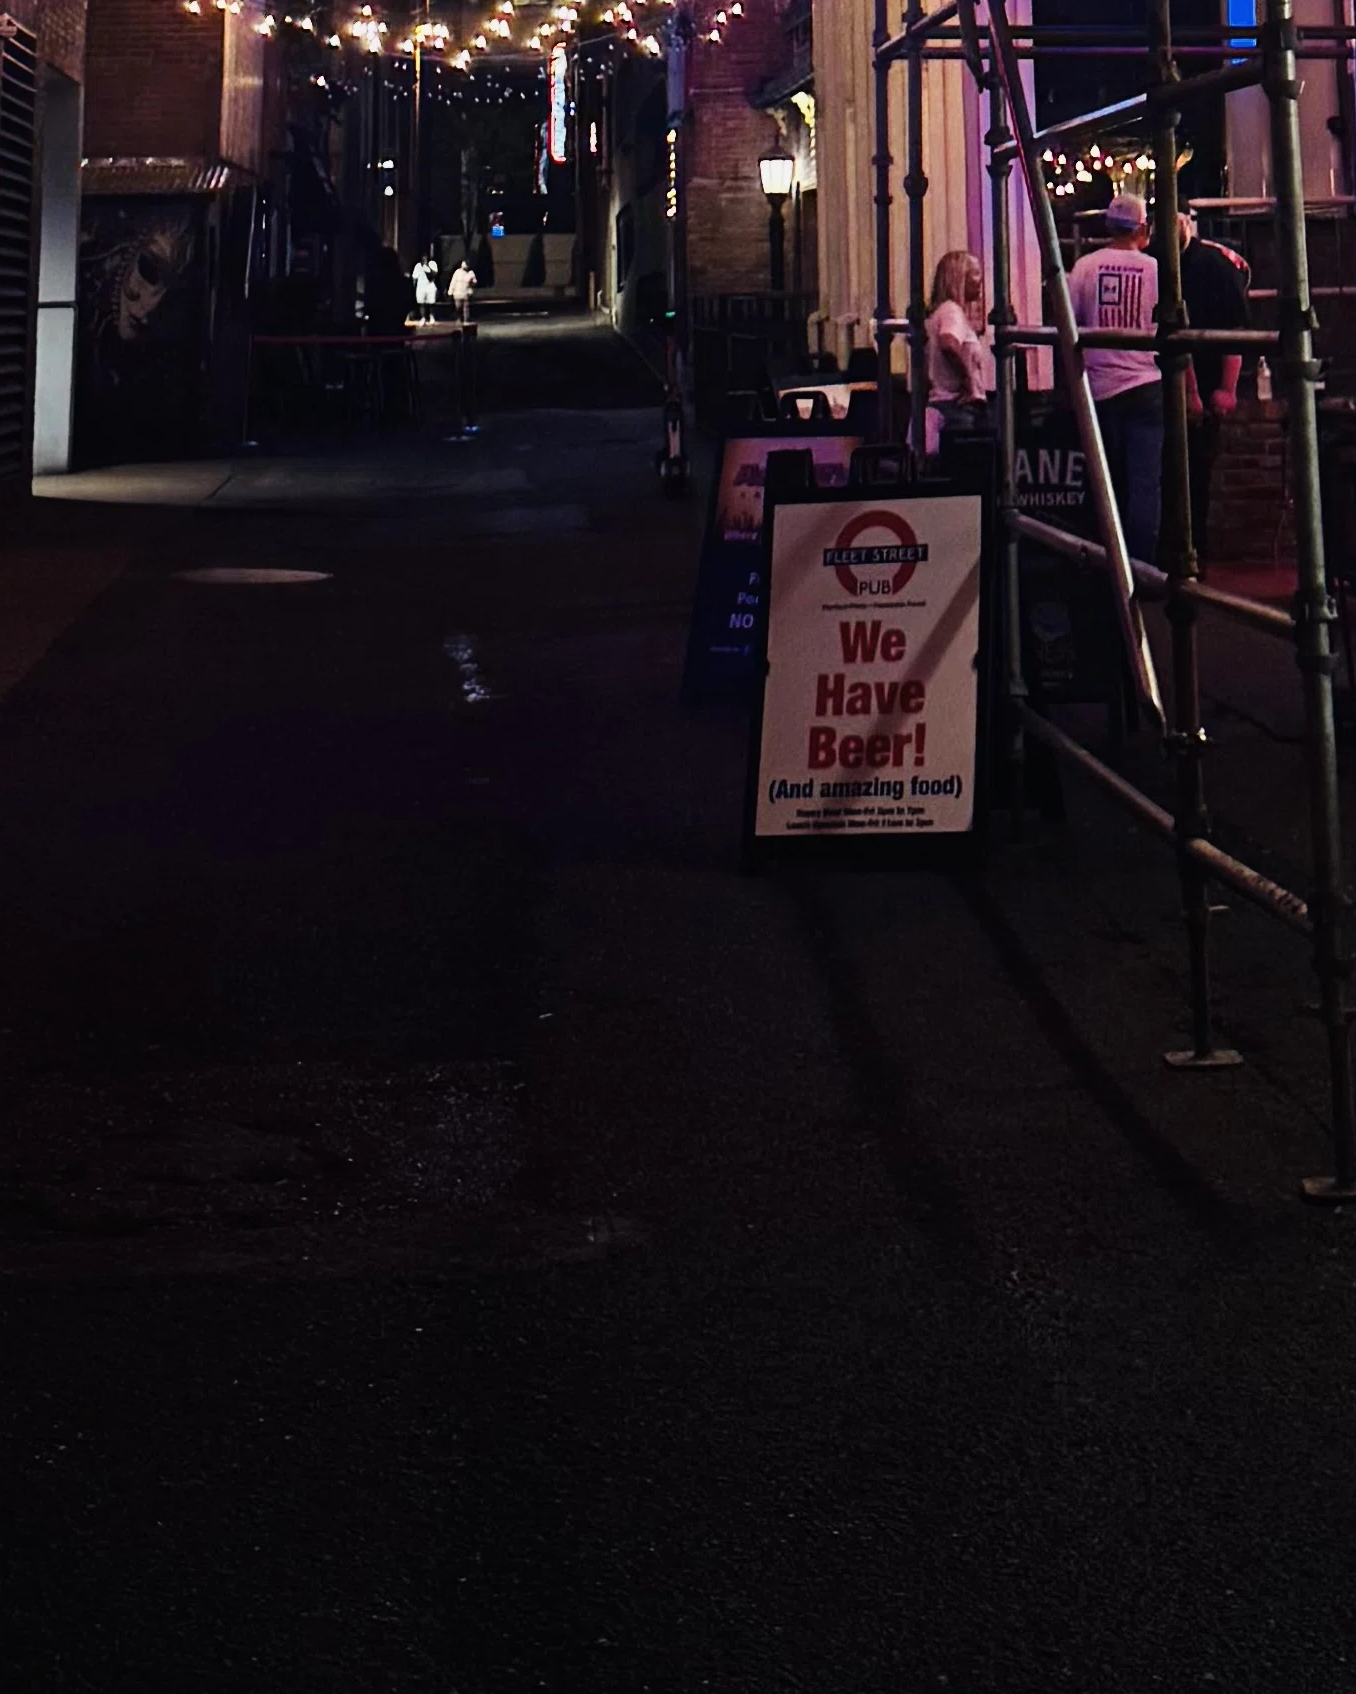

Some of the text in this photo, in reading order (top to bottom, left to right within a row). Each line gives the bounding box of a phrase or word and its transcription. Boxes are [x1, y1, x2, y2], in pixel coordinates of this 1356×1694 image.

[825, 546, 925, 564] FLEET STREET
[859, 580, 892, 596] PUB
[840, 619, 907, 664] We
[815, 673, 926, 717] Have
[808, 722, 927, 770] Beer!
[820, 777, 905, 801] amazing
